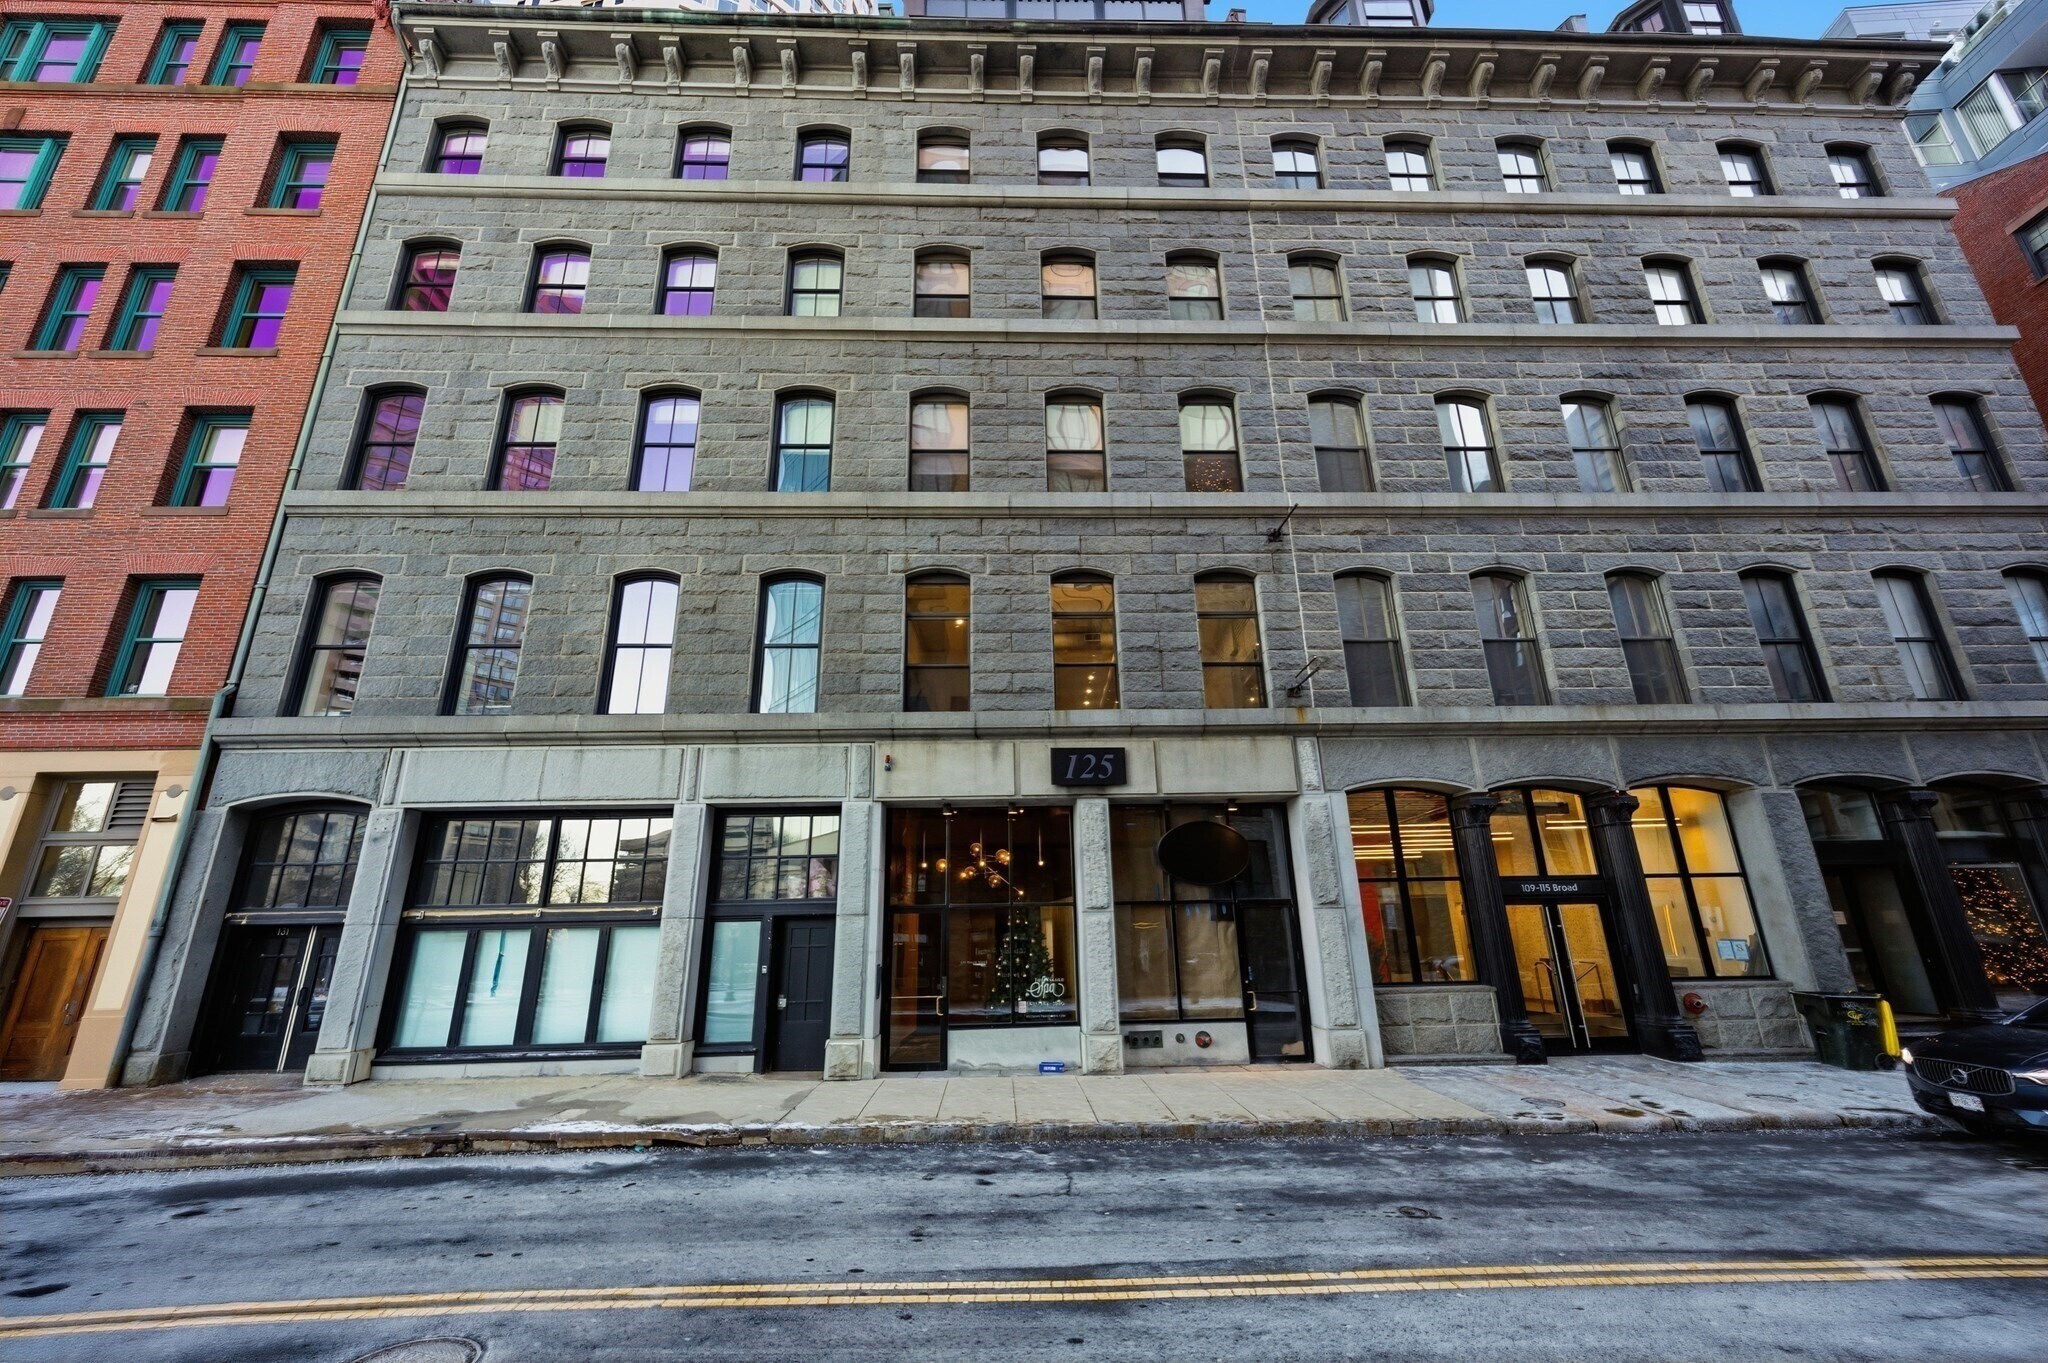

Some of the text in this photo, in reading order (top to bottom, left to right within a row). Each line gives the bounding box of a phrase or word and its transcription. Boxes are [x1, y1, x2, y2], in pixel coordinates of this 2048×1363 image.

[1064, 753, 1114, 779] 125
[1521, 883, 1578, 892] 109-115 Broad
[277, 927, 290, 936] 131
[1026, 975, 1065, 999] Spa
